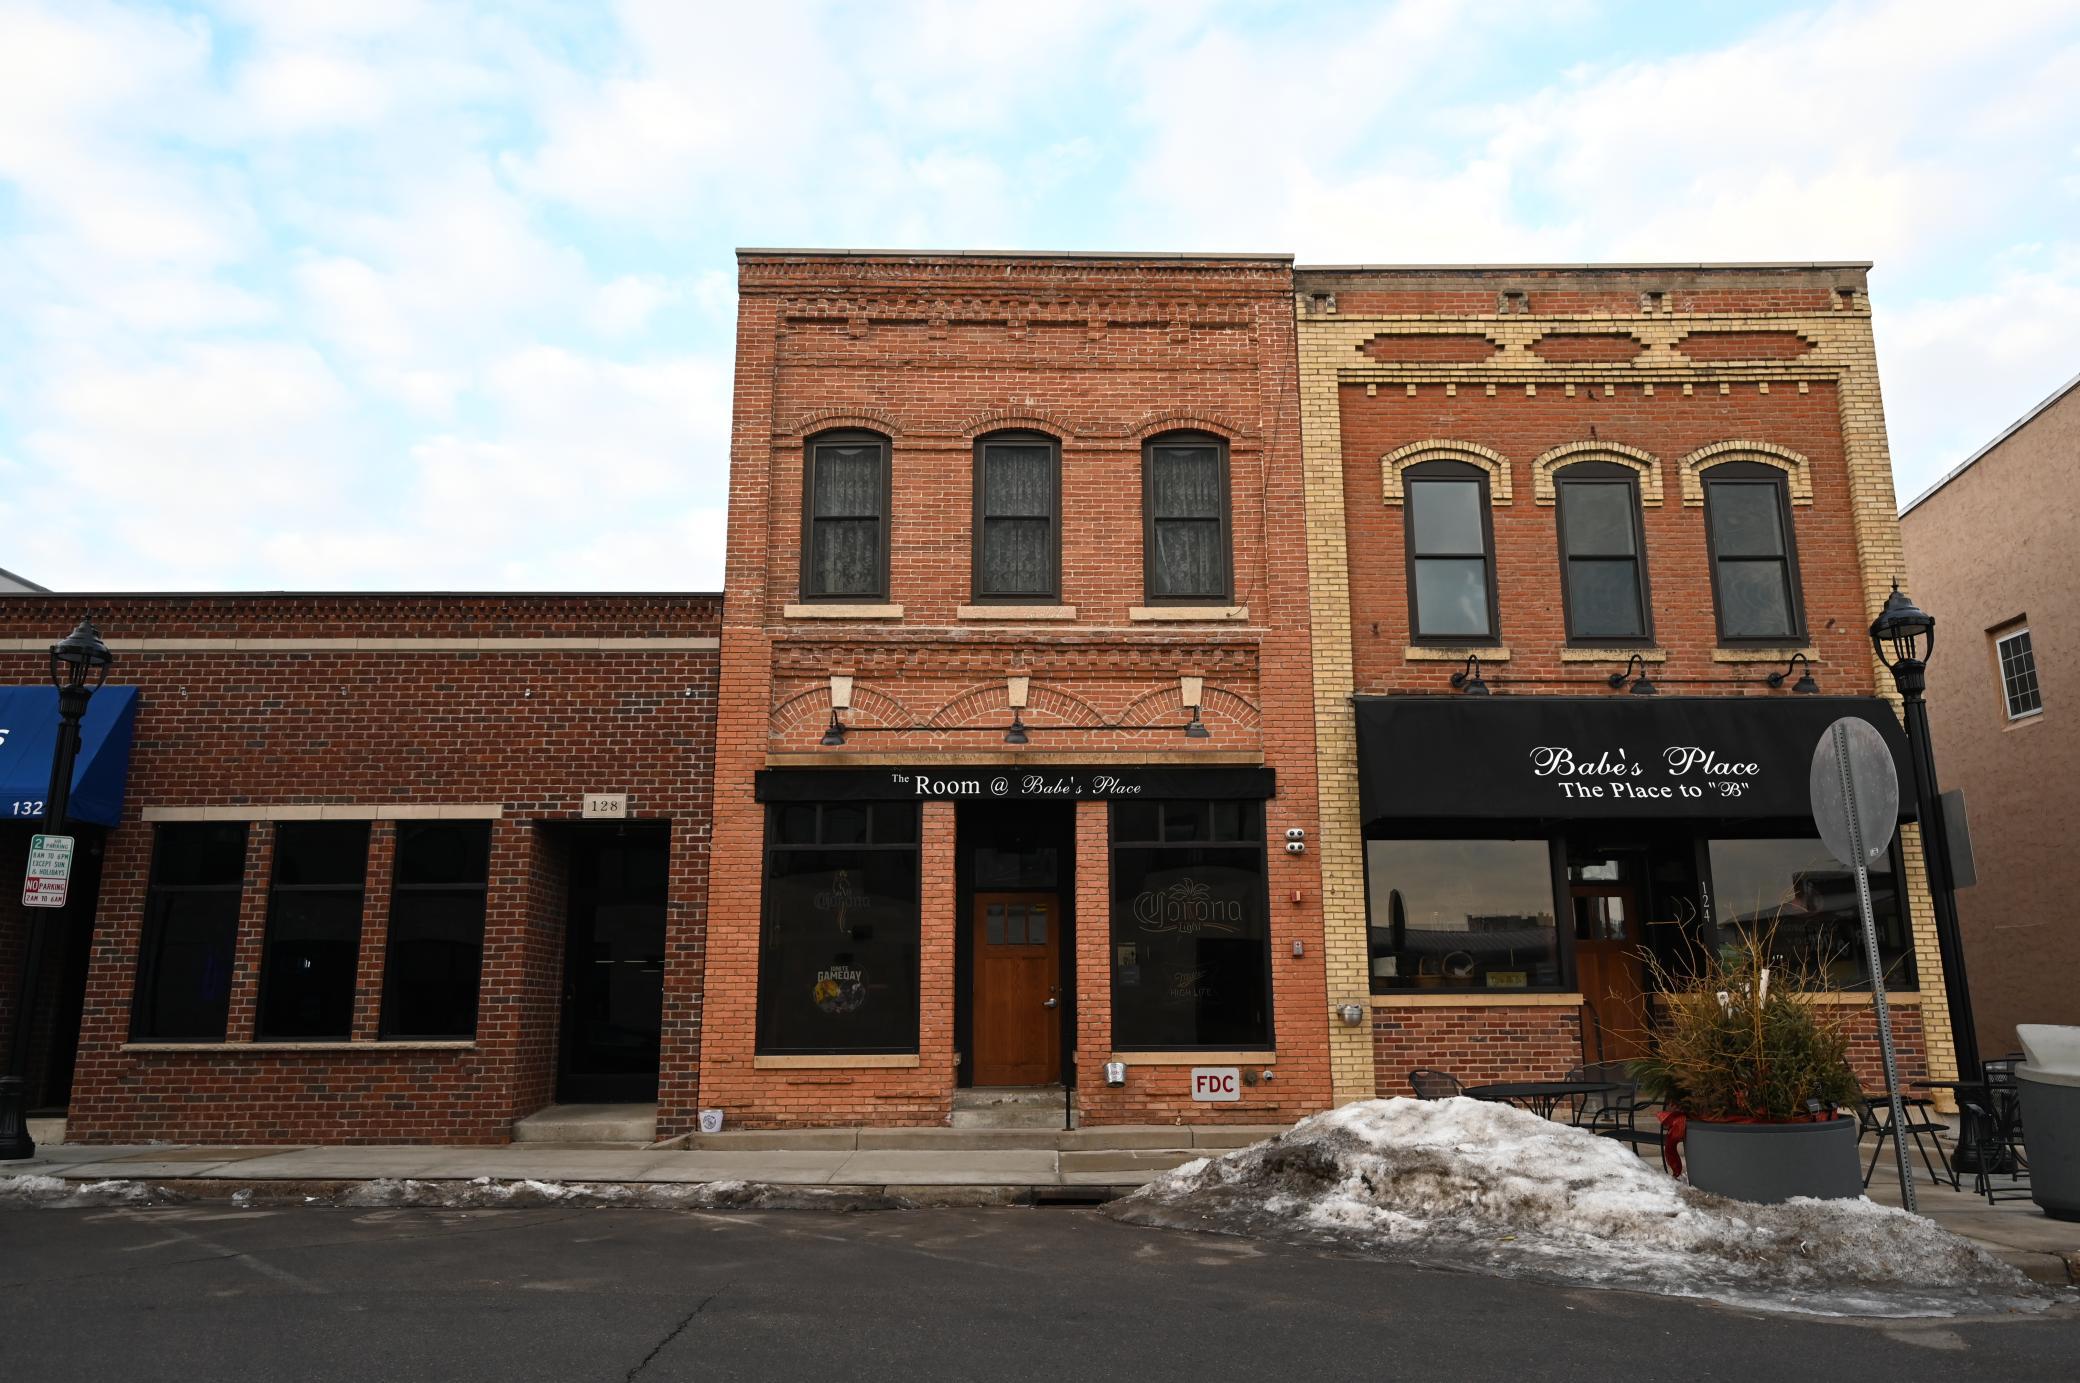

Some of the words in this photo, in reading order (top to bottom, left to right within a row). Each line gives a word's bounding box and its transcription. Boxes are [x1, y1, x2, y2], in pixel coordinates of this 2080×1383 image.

[1663, 746, 1761, 776] Place
[892, 774, 909, 783] The
[915, 775, 981, 794] Room
[990, 776, 1009, 796] @
[1021, 774, 1083, 794] Babe's
[1092, 775, 1142, 794] Place
[1558, 782, 1604, 798] The
[1609, 782, 1673, 798] Place
[1679, 783, 1702, 798] to
[1708, 781, 1750, 798] "B"
[13, 801, 43, 815] 132
[591, 800, 618, 812] 128
[34, 838, 42, 849] 2
[26, 879, 39, 891] NO
[40, 883, 65, 891] PARKING
[1133, 891, 1243, 929] Corona
[1702, 881, 1710, 923] 124
[817, 970, 862, 983] GAMEDAY
[1196, 1075, 1235, 1093] FDC
